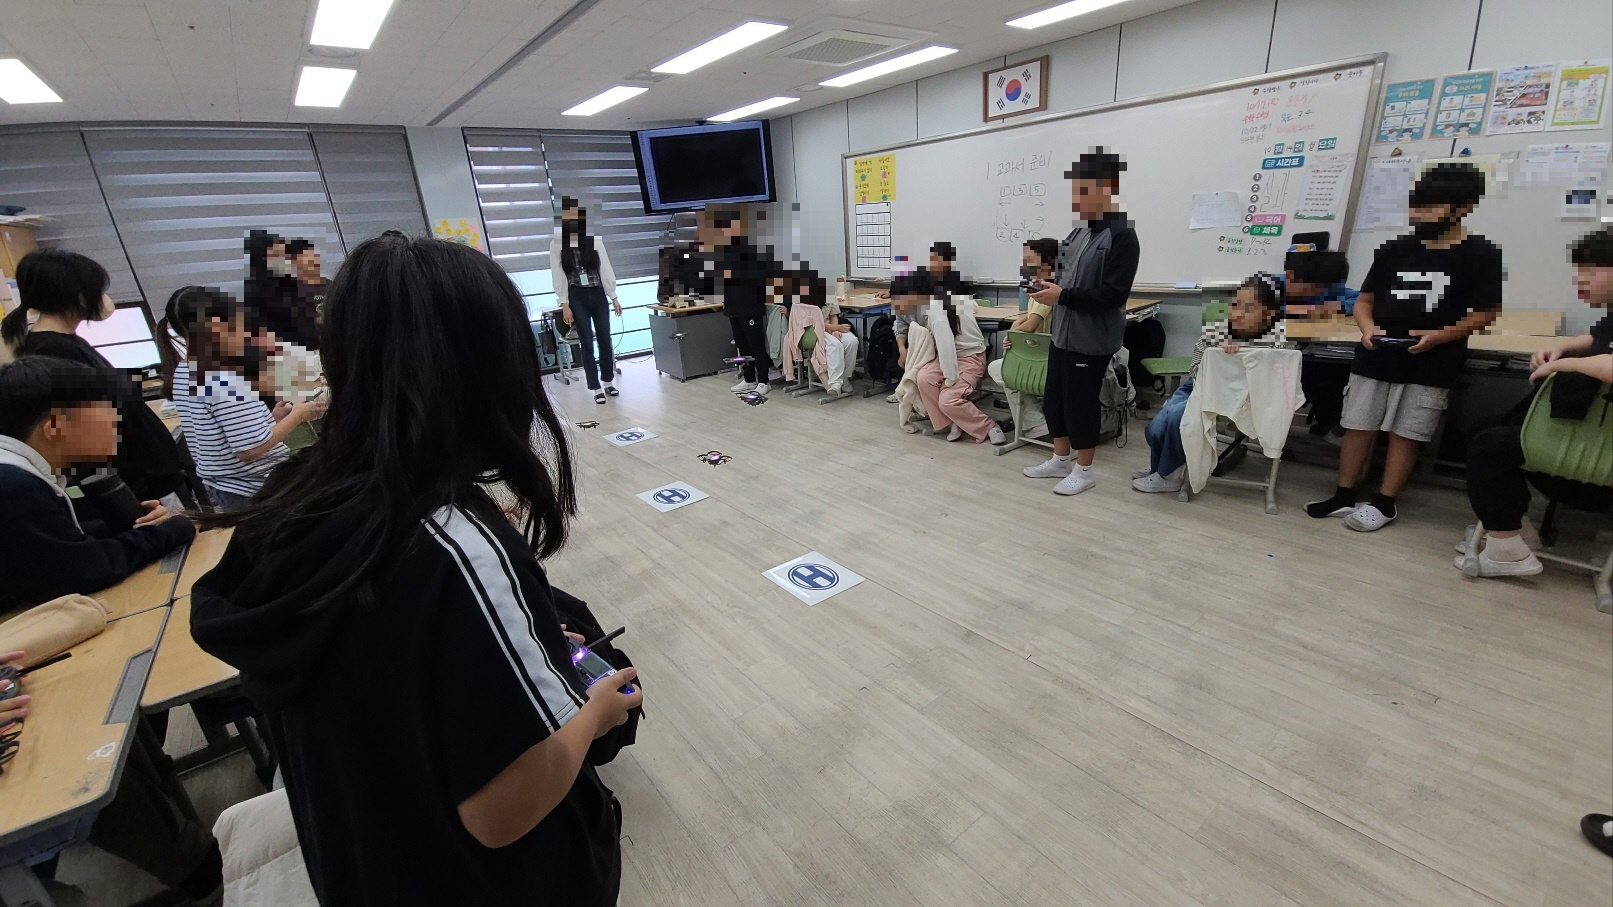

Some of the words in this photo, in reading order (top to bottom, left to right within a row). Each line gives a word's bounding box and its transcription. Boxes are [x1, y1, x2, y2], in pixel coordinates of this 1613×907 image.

[1294, 142, 1303, 151] 일
[1318, 139, 1336, 149] 요일
[997, 158, 1025, 176] 교과서
[1029, 151, 1053, 171] 준비
[1276, 158, 1300, 167] 시간표
[1260, 170, 1290, 212] 실과
[1262, 226, 1279, 234] 체육
[618, 429, 643, 441] H
[655, 488, 688, 504] H
[790, 565, 837, 589] H
